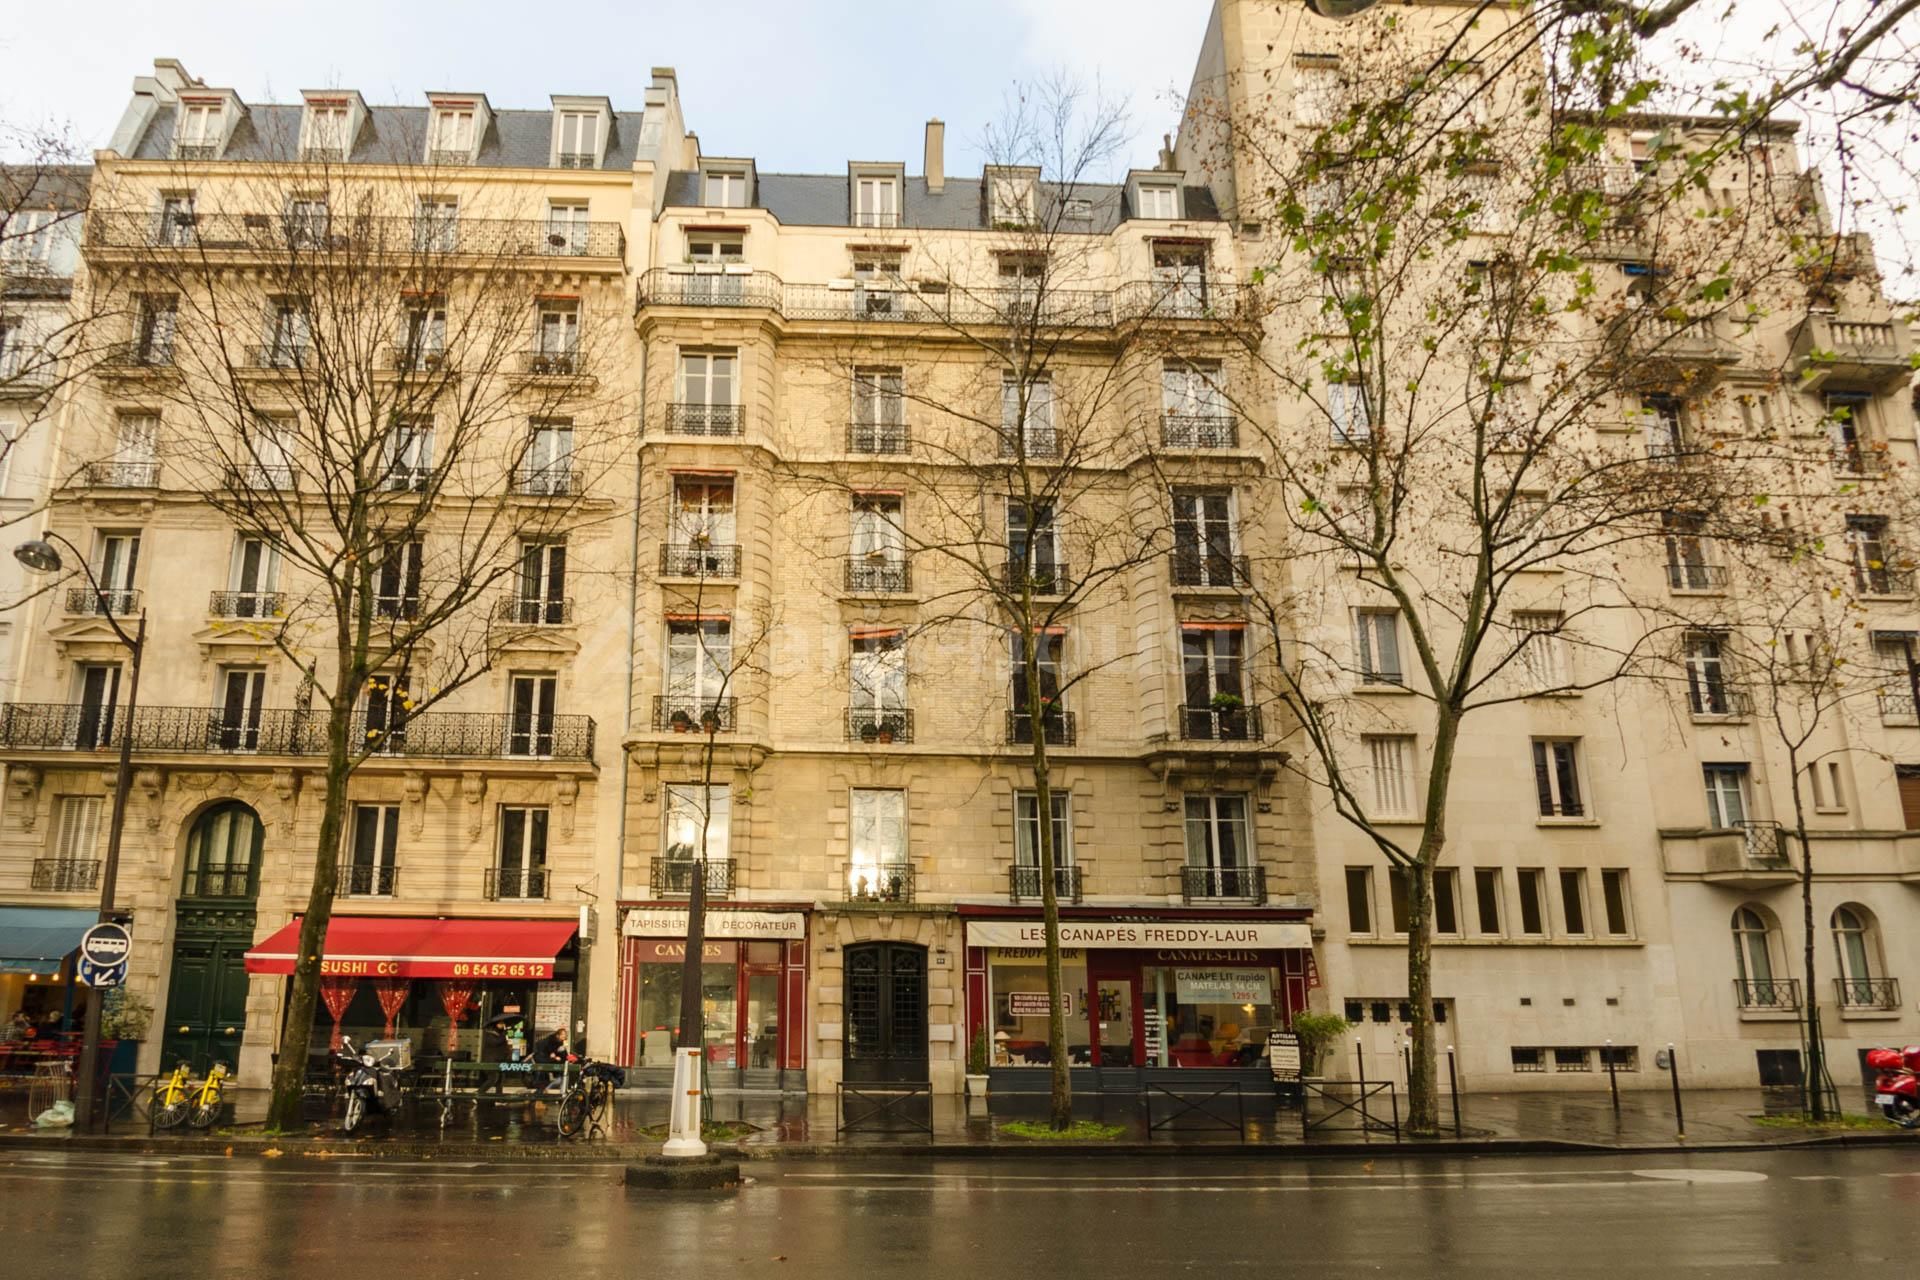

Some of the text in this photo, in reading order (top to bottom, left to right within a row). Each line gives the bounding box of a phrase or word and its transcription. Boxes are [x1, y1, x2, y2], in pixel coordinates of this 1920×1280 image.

[631, 919, 686, 928] TAPISSIER
[1021, 926, 1259, 942] LES CANAPÉS FREDDY-LAUR
[655, 944, 722, 956] CANES
[320, 961, 399, 974] SUSHI CC
[454, 964, 544, 976] 09 54 52 65 12
[1236, 973, 1266, 983] rapido
[1190, 982, 1231, 990] MATELAS
